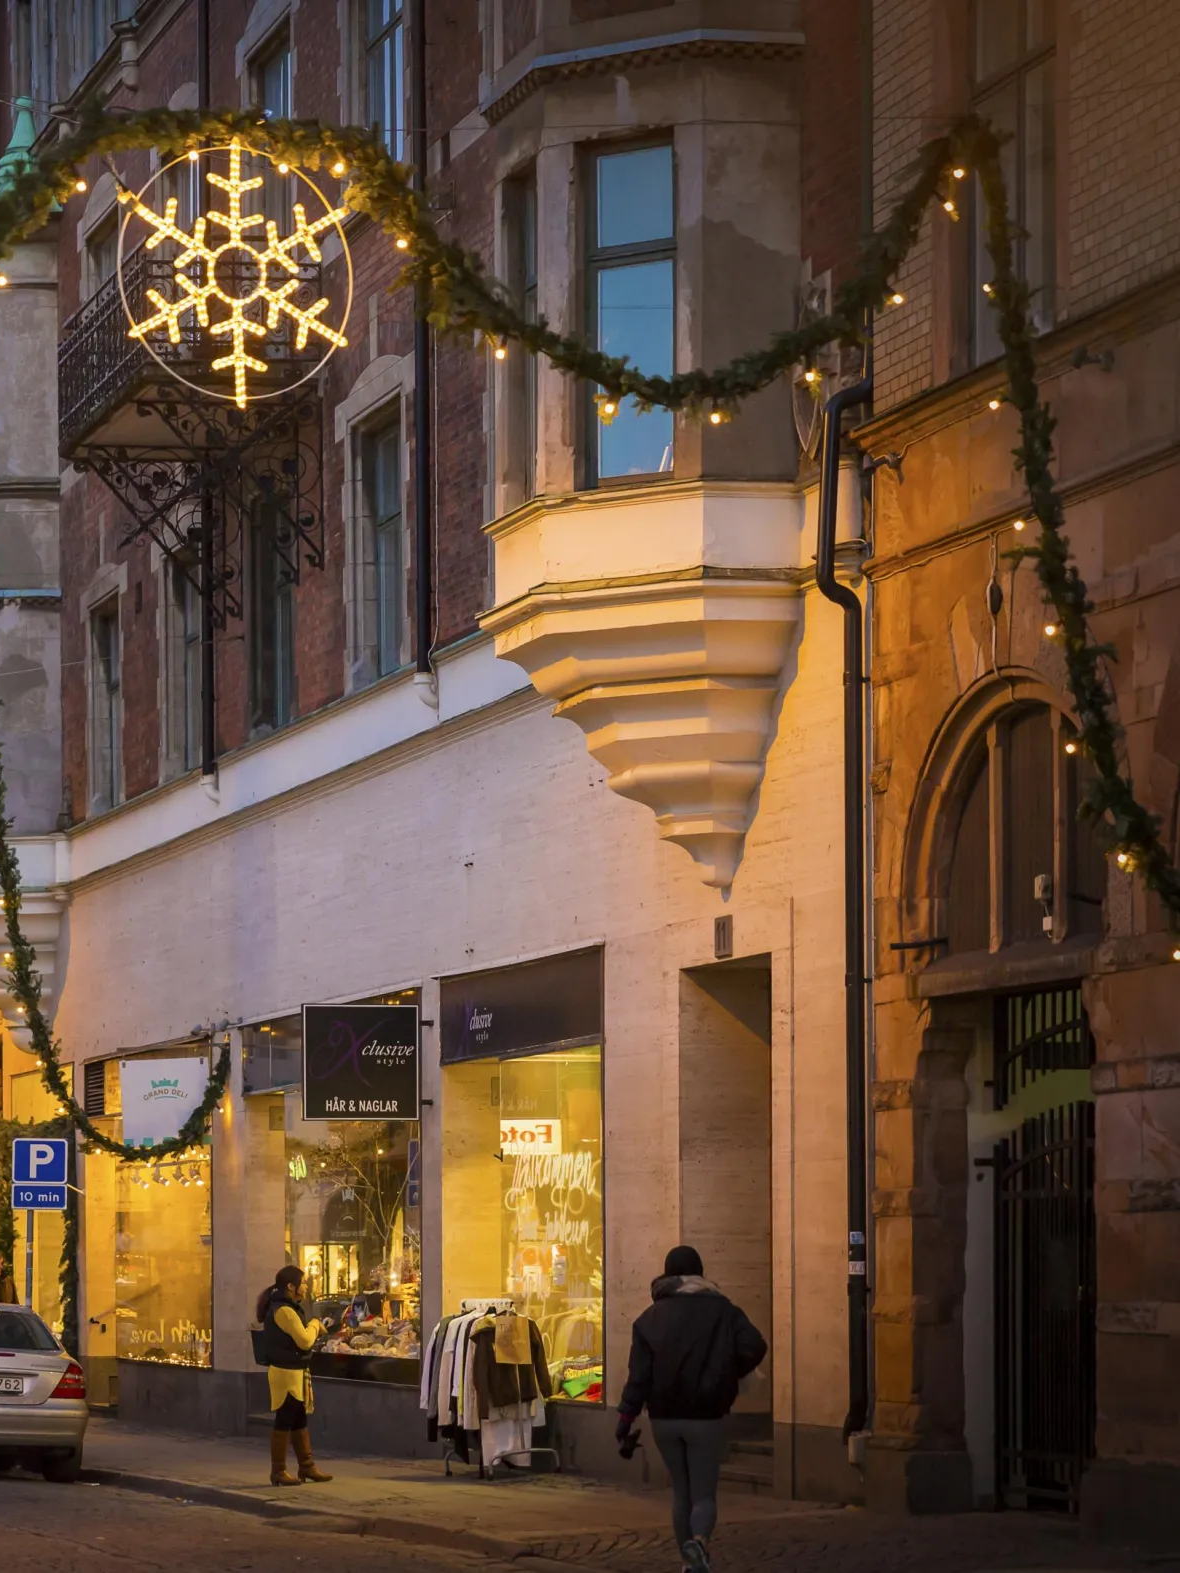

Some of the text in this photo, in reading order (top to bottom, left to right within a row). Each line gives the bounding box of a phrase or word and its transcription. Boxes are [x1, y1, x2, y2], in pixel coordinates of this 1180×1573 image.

[376, 1057, 406, 1067] style
[143, 1088, 189, 1101] GRAND DELI
[325, 1096, 398, 1112] HÅR & NAGLAR
[29, 1143, 55, 1179] P
[19, 1191, 60, 1202] 10 min
